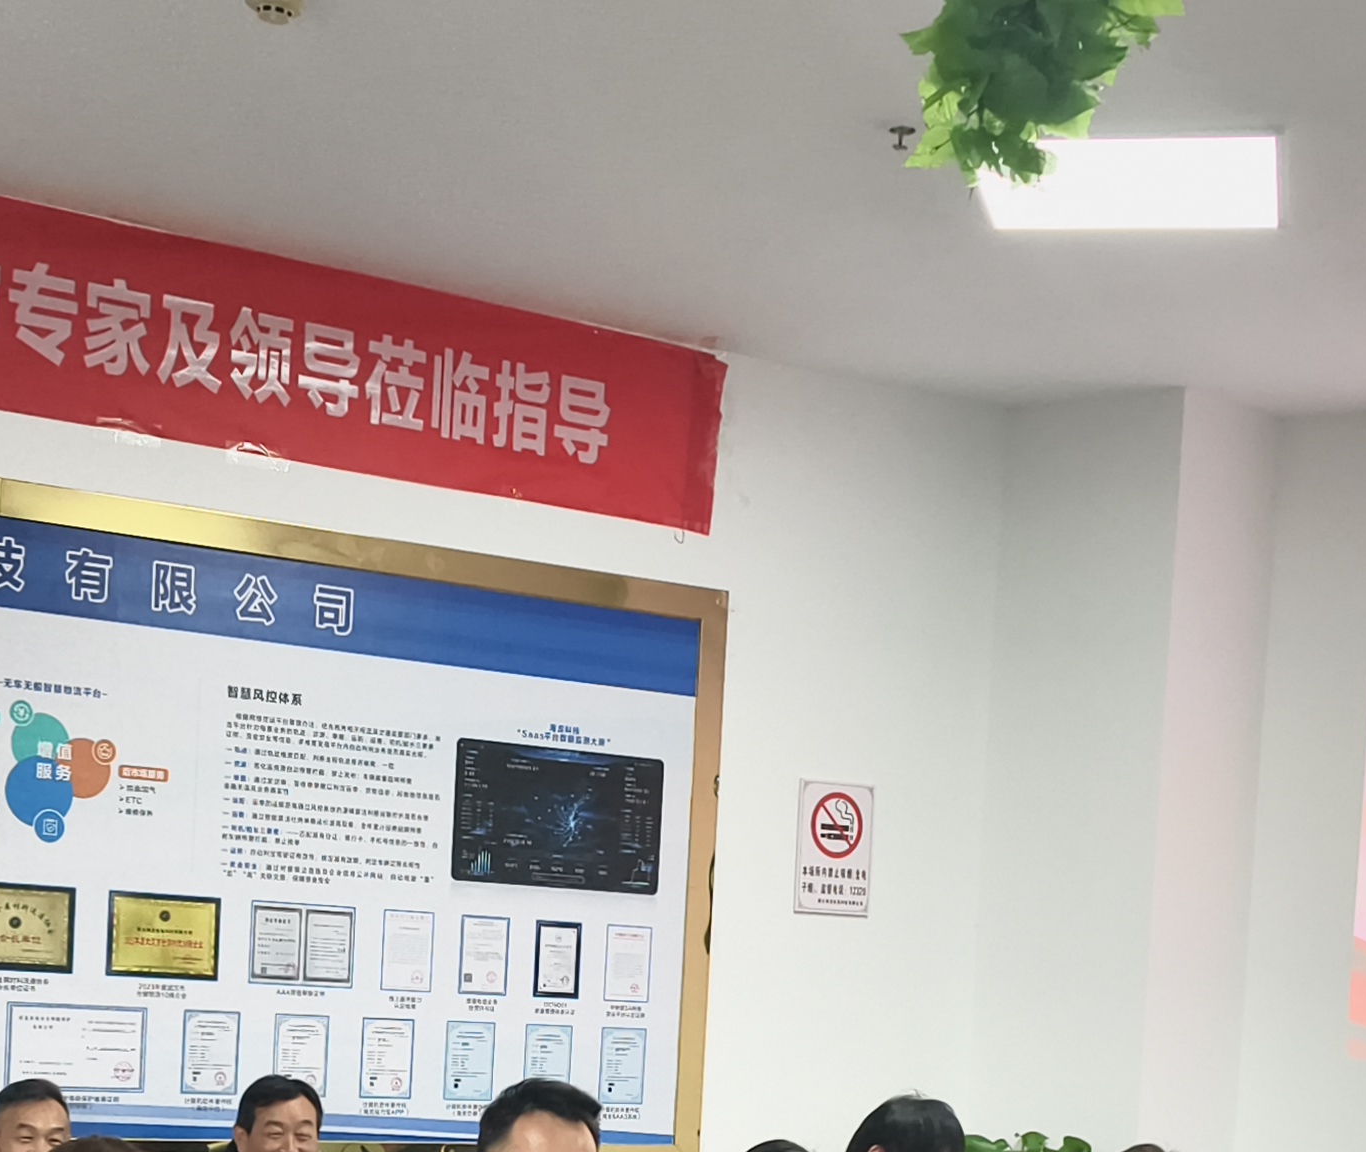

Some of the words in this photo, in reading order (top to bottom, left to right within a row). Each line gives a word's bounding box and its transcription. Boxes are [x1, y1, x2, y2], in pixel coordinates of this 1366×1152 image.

[227, 684, 303, 707] 智慧风控体系
[37, 740, 73, 761] 增值
[36, 762, 73, 782] 服务
